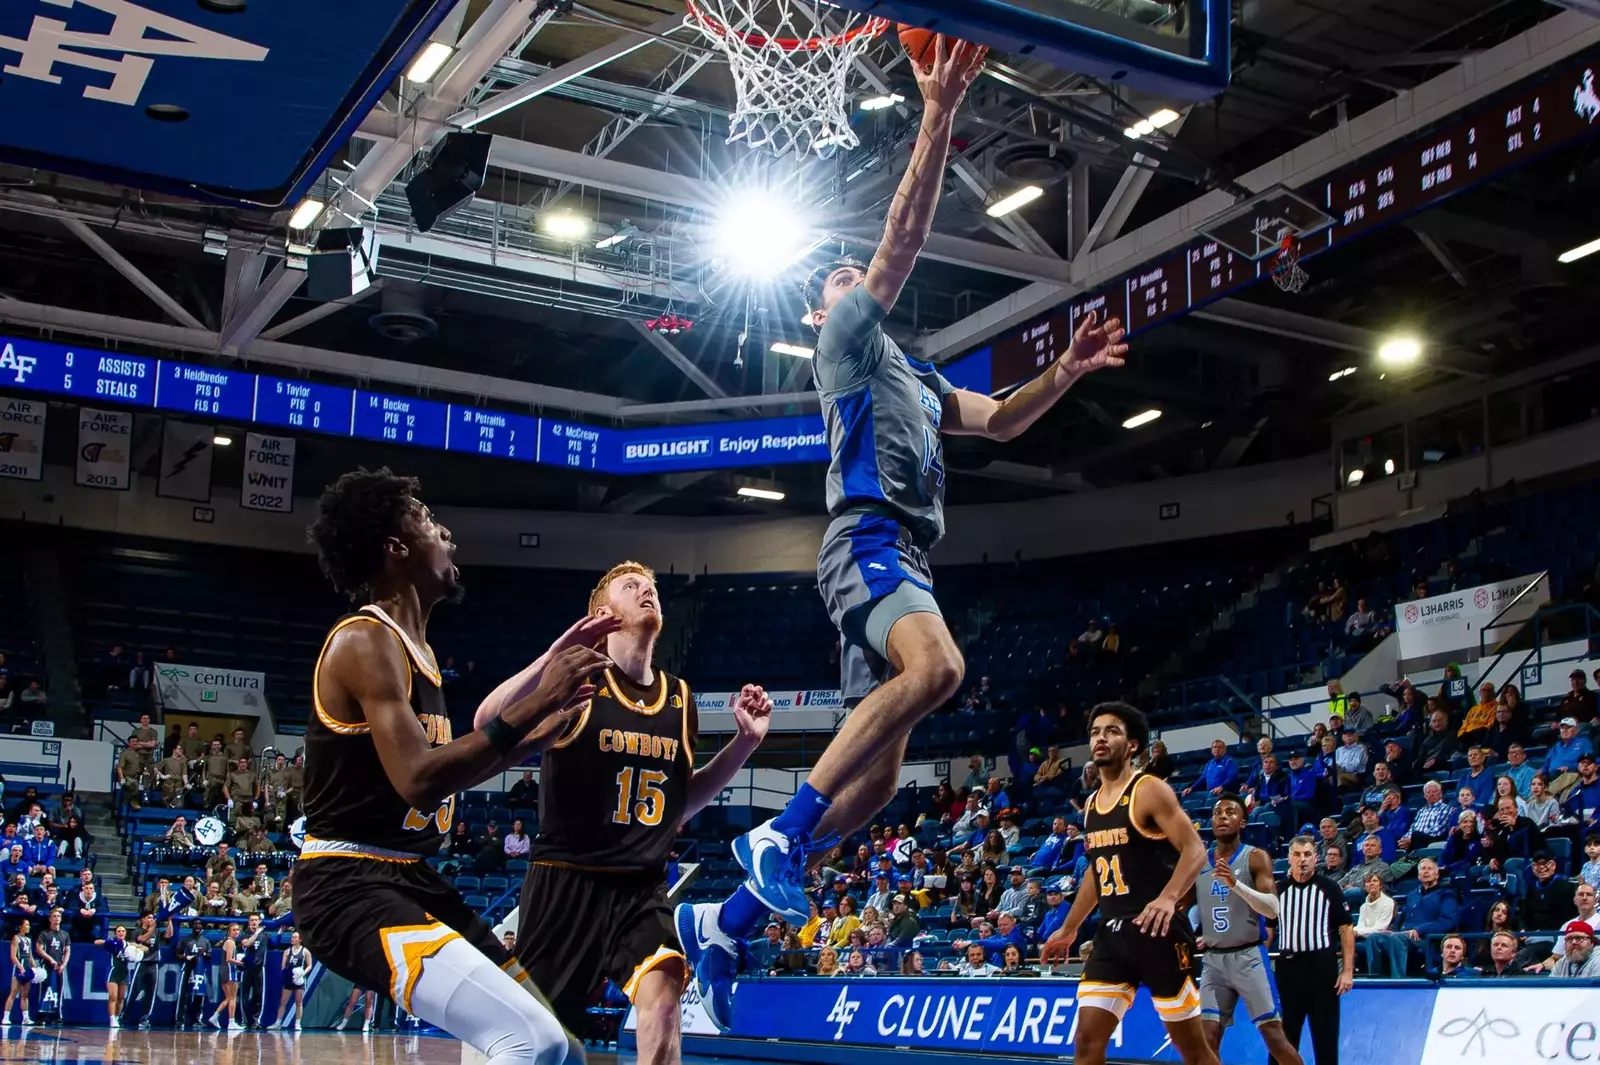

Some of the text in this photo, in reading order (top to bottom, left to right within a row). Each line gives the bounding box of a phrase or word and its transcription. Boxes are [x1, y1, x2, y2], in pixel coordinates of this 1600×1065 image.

[1506, 97, 1539, 128] AST 4
[1436, 140, 1451, 160] REB
[1468, 127, 1475, 144] 3
[1508, 122, 1541, 152] STL 2
[1437, 164, 1452, 184] REB
[1162, 298, 1168, 312] 2
[0, 343, 37, 383] AF
[65, 352, 146, 378] 9 ASSISTS
[174, 367, 228, 385] 3 Heidbreder
[64, 374, 137, 398] 5 STEALS
[196, 384, 220, 398] PTS 0
[277, 382, 311, 397] 5 Taylor
[8, 402, 32, 414] AIR
[195, 400, 219, 413] FLS 0
[290, 398, 321, 413] PTS 0
[370, 396, 410, 412] 14 Becker
[94, 413, 117, 423] AIR
[289, 413, 320, 428] FLS 0
[385, 411, 415, 427] PTS 12
[464, 410, 471, 422] 31
[82, 421, 129, 434] FORCE
[383, 427, 413, 441] FLS 0
[480, 426, 516, 442] PTS 7
[552, 424, 599, 442] 42 McCreary
[261, 438, 280, 451] AIR
[479, 441, 515, 457] FLS 2
[569, 440, 582, 451] PTS
[626, 444, 660, 459] BUD
[662, 439, 710, 456] LIGHT
[720, 437, 758, 453] Enjoy
[249, 450, 290, 467] FORCE
[568, 454, 580, 466] FLS
[86, 474, 117, 485] 2013
[248, 472, 287, 489] WNIT
[250, 494, 283, 508] 2022
[1420, 598, 1464, 617] L3HARRIS
[194, 671, 260, 690] centura
[1525, 667, 1538, 680] L4
[811, 691, 837, 699] FIRST
[1452, 681, 1464, 693] L3
[45, 743, 60, 752] L19
[599, 728, 678, 762] COWBOYS
[612, 766, 668, 827] 15
[1095, 854, 1129, 897] 21
[1210, 880, 1230, 903] AF
[1212, 906, 1231, 933] 5
[827, 984, 860, 1041] AF
[877, 994, 992, 1041] CLUNE
